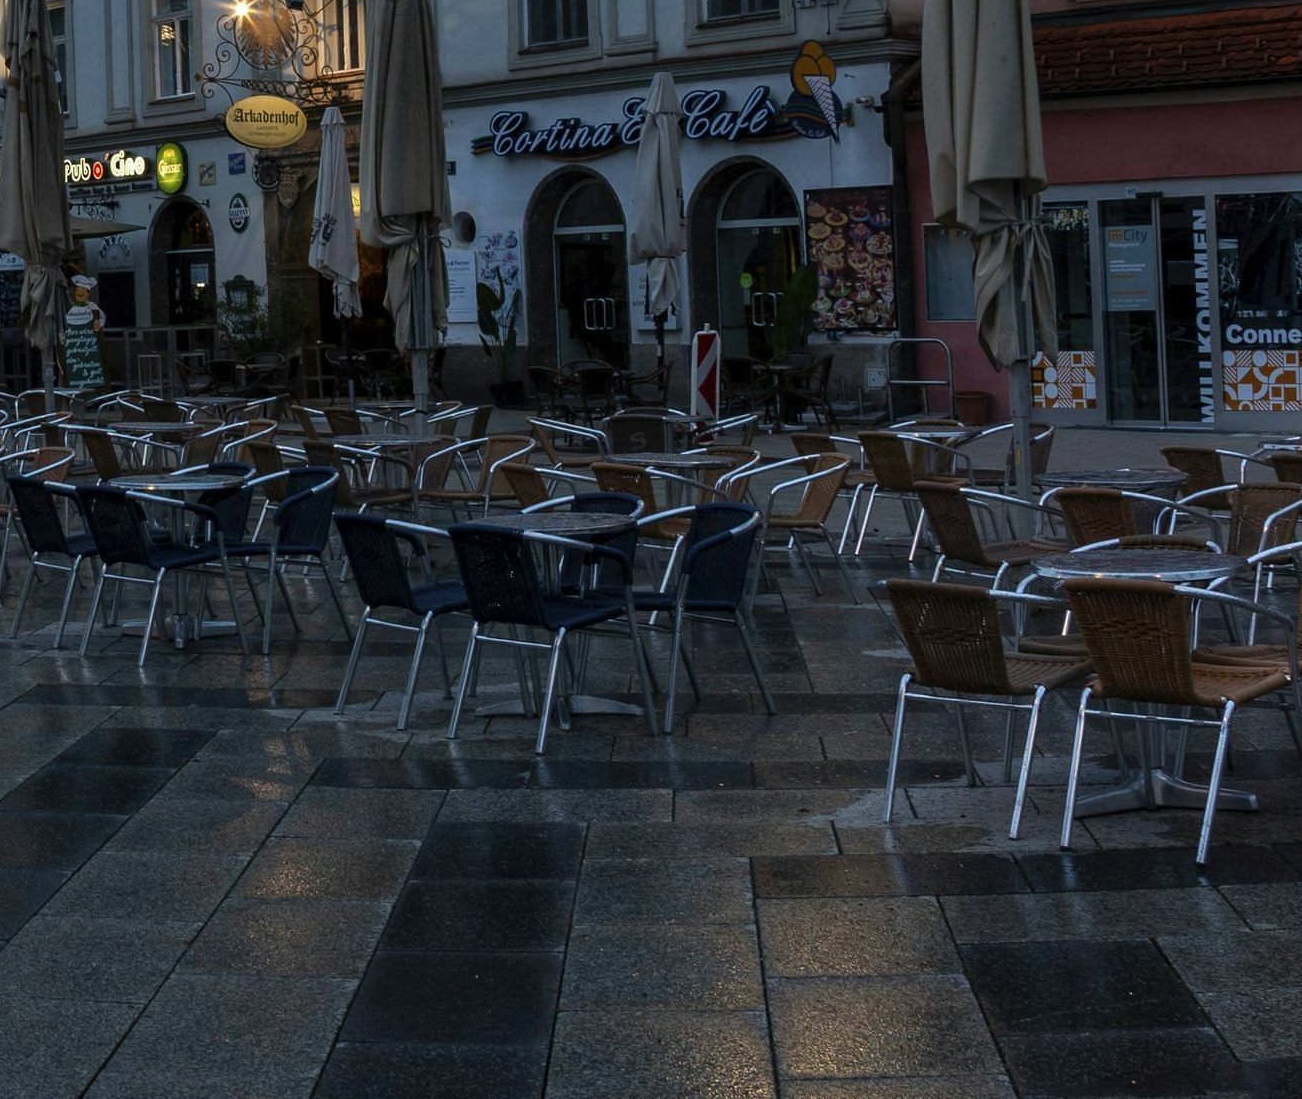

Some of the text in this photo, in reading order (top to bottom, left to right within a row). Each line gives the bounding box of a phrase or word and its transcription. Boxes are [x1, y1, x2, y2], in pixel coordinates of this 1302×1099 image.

[233, 108, 300, 127] Arkadenhof
[491, 111, 615, 157] Cortina
[63, 158, 91, 183] Pub
[110, 149, 146, 177] Cino
[1225, 323, 1302, 344] Conne
